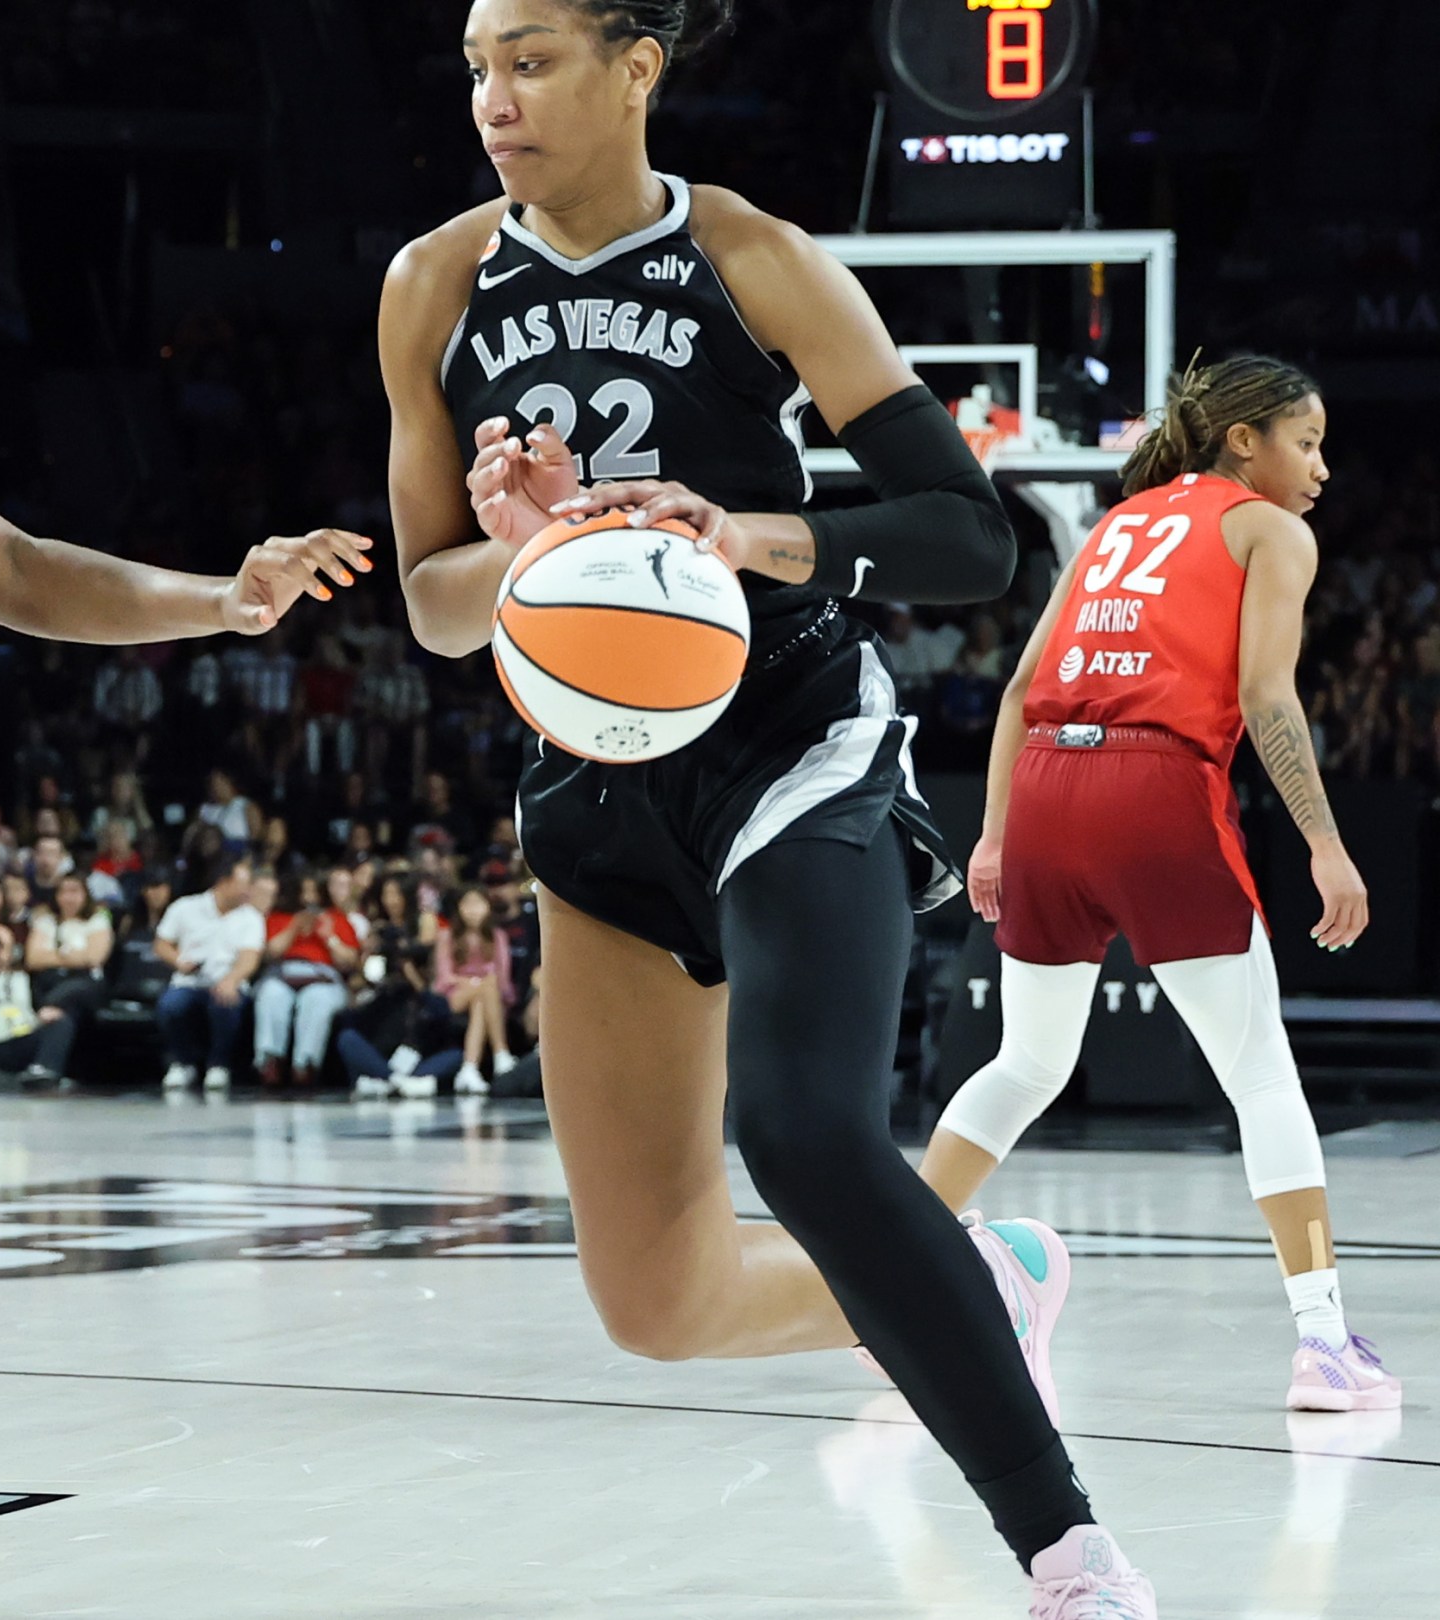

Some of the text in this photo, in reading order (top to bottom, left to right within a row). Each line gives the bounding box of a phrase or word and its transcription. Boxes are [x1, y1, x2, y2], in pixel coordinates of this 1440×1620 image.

[987, 8, 1044, 100] 8
[642, 254, 696, 286] ally
[470, 298, 701, 382] LAS VEGAS
[515, 378, 660, 480] 22
[1083, 513, 1192, 596] 52
[1074, 598, 1144, 635] HARRIS
[1086, 650, 1153, 676] AT&T
